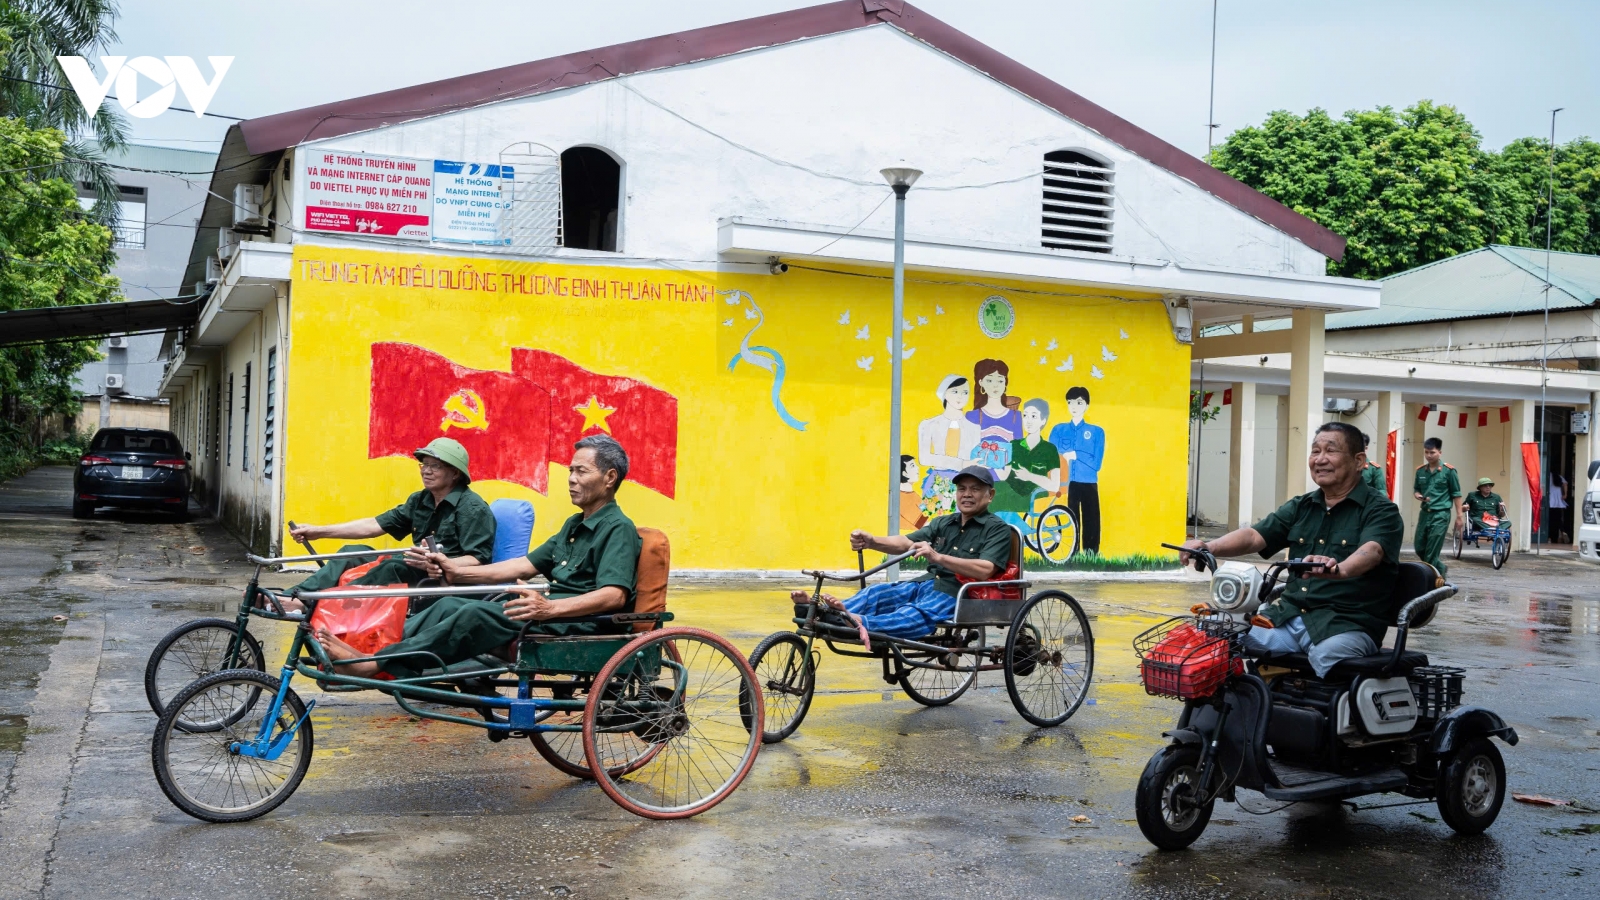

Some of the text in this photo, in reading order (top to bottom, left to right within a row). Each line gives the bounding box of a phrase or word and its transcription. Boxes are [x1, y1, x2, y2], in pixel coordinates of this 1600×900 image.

[323, 154, 416, 171] HỆ THỐNG TRUYỀN HÌNH
[308, 166, 431, 187] VÀ MẠNG INTERNET CÁP QUANG
[455, 177, 493, 187] HỆ THỐNG
[310, 181, 321, 190] DO
[323, 183, 353, 193] VIETTEL
[356, 185, 377, 197] PHỤC
[379, 187, 389, 198] VỤ
[414, 189, 427, 200] PHÍ
[446, 188, 501, 198] MẠNG INTERNE
[365, 200, 384, 211] 0984
[386, 202, 401, 212] 627
[403, 204, 417, 213] 210
[470, 200, 492, 208] CUNG
[478, 211, 491, 219] PHÍ
[403, 229, 429, 237] viettel
[298, 259, 359, 284] TRUNG
[360, 262, 396, 286] TÂM
[397, 261, 434, 288] ĐIỀU
[438, 264, 497, 292] DƯỠNG
[572, 278, 607, 299] BINH
[665, 281, 715, 303] THÀNH
